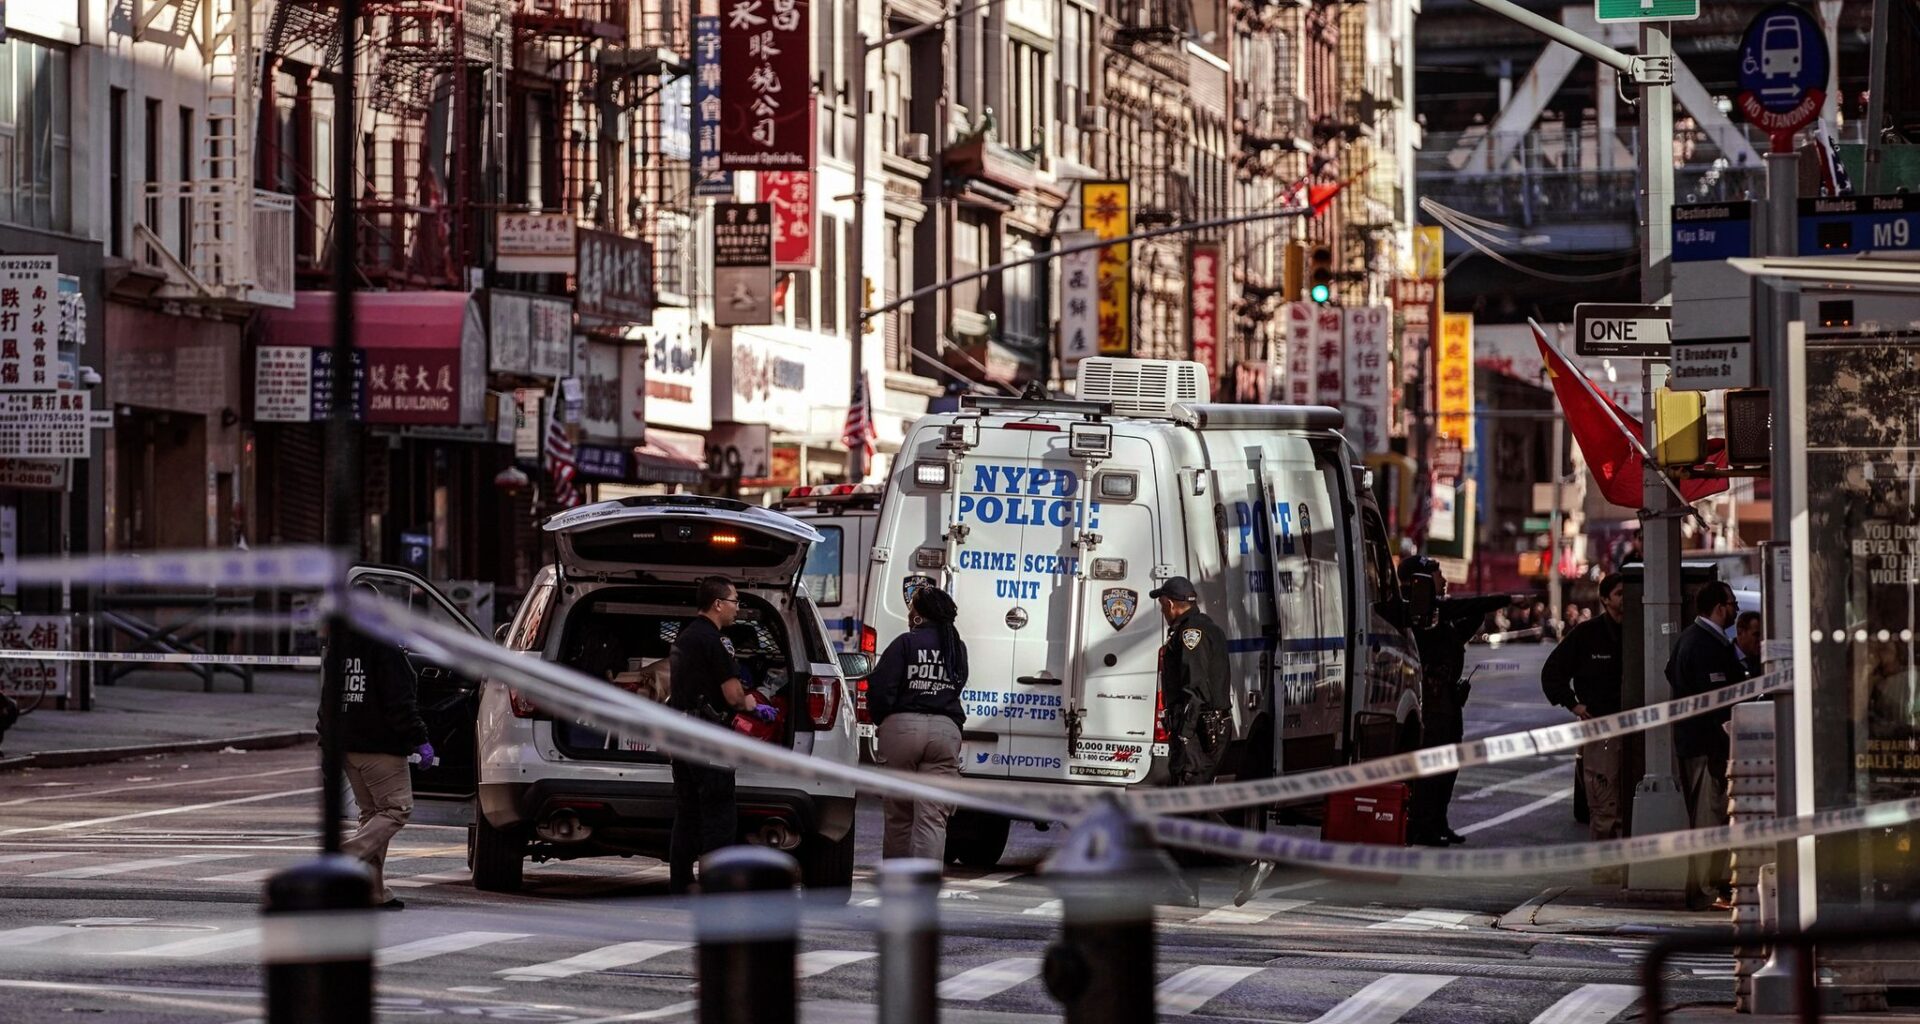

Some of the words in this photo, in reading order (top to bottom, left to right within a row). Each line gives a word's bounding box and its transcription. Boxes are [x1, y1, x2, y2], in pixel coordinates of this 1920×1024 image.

[1744, 96, 1761, 117] NO
[1762, 96, 1816, 128] STANDING
[1815, 200, 1857, 212] Minutes
[1873, 197, 1904, 210] Route
[1676, 206, 1730, 220] Destination
[1676, 230, 1696, 243] Kips
[1698, 229, 1716, 243] Bay
[1873, 218, 1910, 247] M9
[1590, 320, 1637, 341] ONE
[1676, 350, 1682, 361] E
[1684, 348, 1729, 362] Broadway
[1676, 364, 1719, 379] Catherine
[1721, 364, 1732, 377] St
[370, 396, 393, 411] JSM
[395, 396, 450, 411] BUILDING
[973, 464, 1079, 497] NYPD
[950, 496, 1101, 529] POLICE
[1863, 523, 1891, 540] YOU
[1852, 540, 1902, 555] REVEAL
[959, 550, 1016, 572] CRIME
[1024, 553, 1079, 576] SCENE
[1880, 555, 1898, 569] TO
[996, 579, 1040, 600] UNIT
[962, 690, 998, 703] CRIME
[1003, 692, 1062, 707] STOPPERS
[965, 704, 1057, 721] 1-800-577-TIPS
[1105, 743, 1143, 754] REWARD
[991, 755, 1062, 769] @NYPDTIPS
